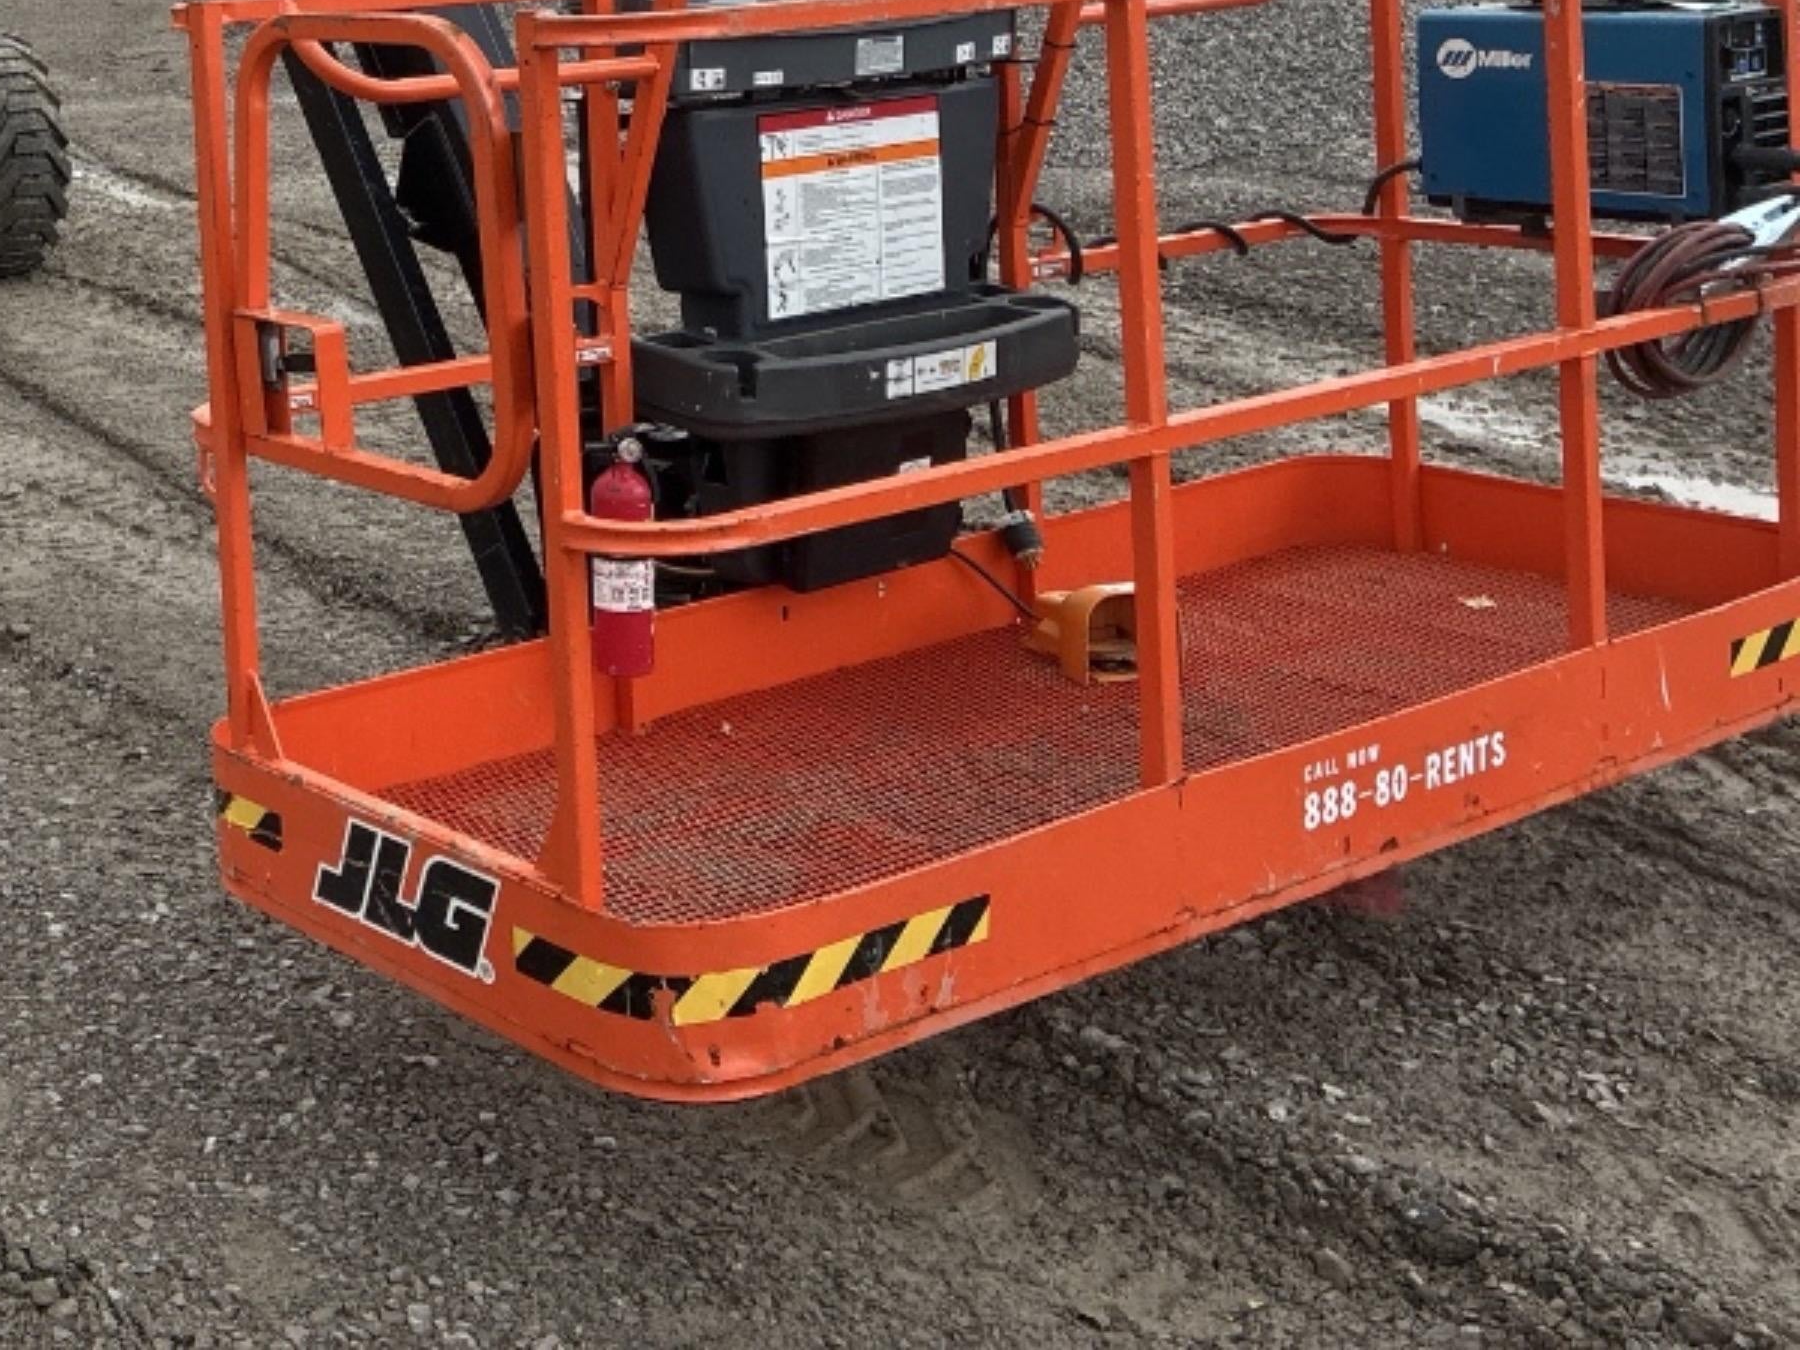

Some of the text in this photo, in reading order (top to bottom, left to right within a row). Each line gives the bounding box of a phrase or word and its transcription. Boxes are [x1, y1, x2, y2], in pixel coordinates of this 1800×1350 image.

[1477, 49, 1534, 69] Miller
[1303, 743, 1381, 784] CALL NOW
[1303, 730, 1507, 832] 888-80-RENTS
[311, 815, 502, 980] JLG
